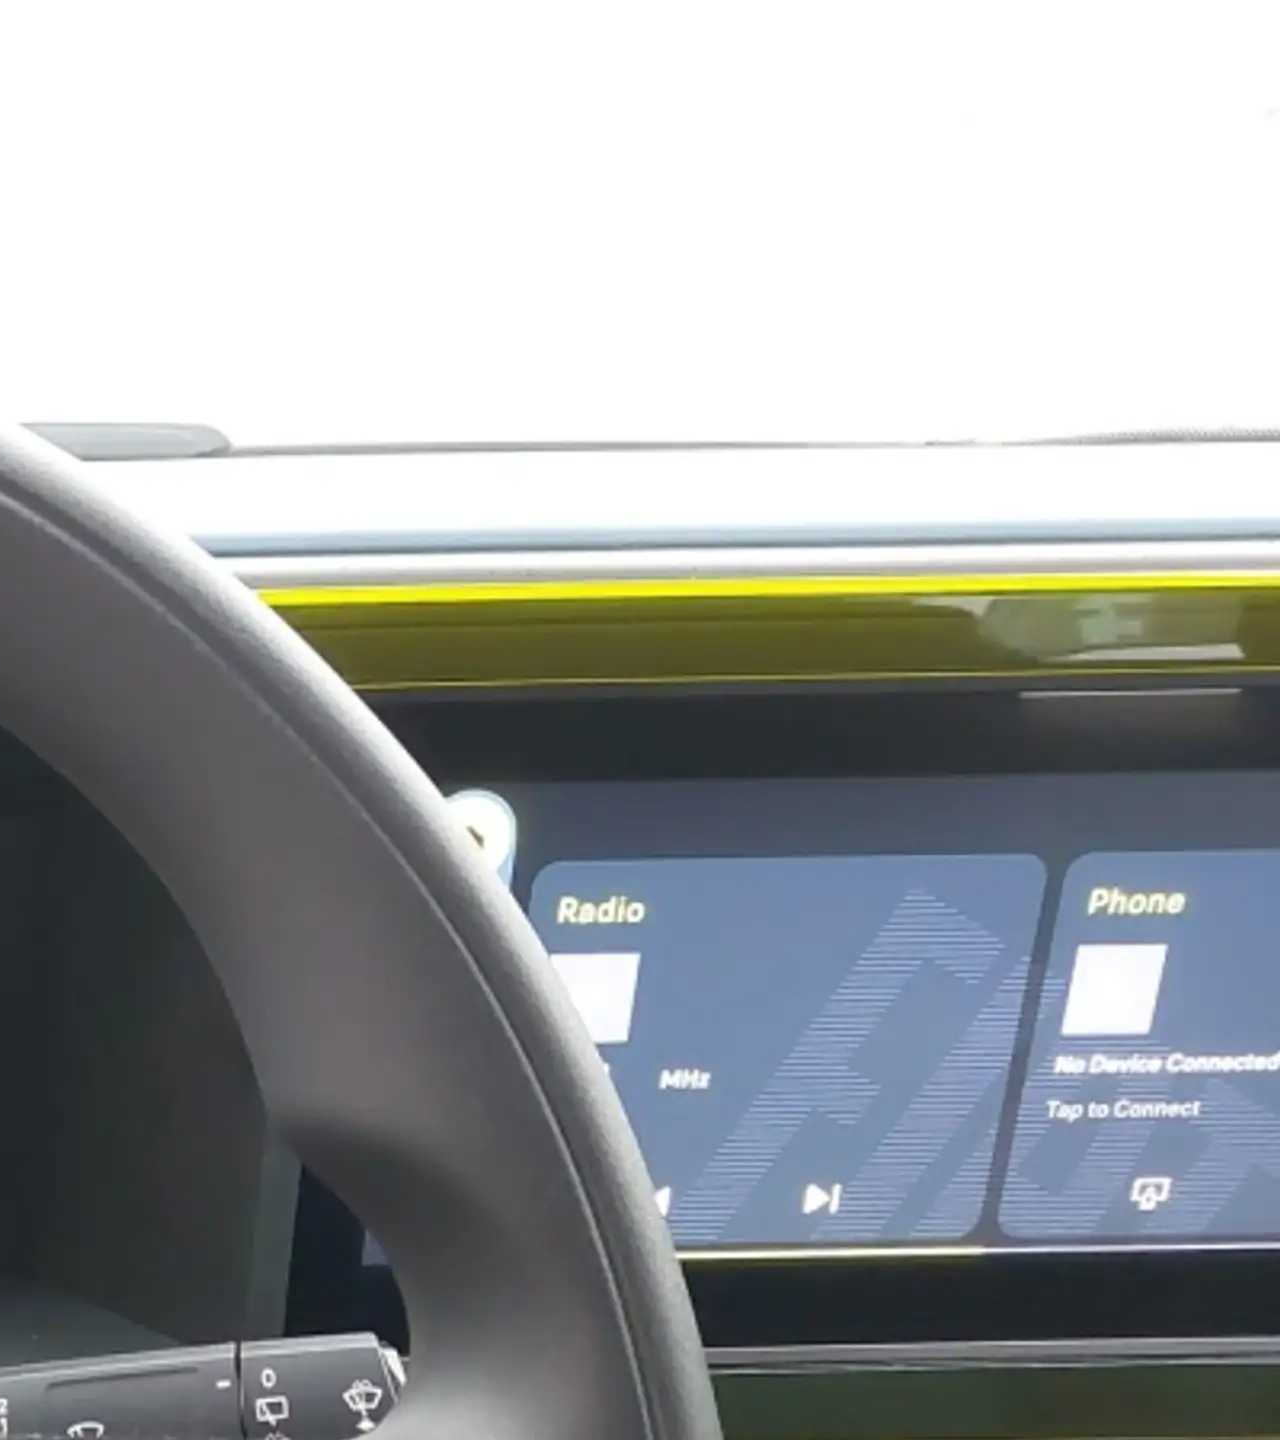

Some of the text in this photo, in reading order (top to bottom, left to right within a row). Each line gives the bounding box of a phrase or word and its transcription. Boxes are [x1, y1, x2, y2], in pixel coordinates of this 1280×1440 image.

[556, 895, 646, 925] Radio
[1087, 886, 1187, 917] Phone
[1053, 1055, 1087, 1074] No
[1088, 1053, 1163, 1074] Device
[658, 1068, 712, 1090] MHz
[1046, 1098, 1202, 1124] Tap to Connect
